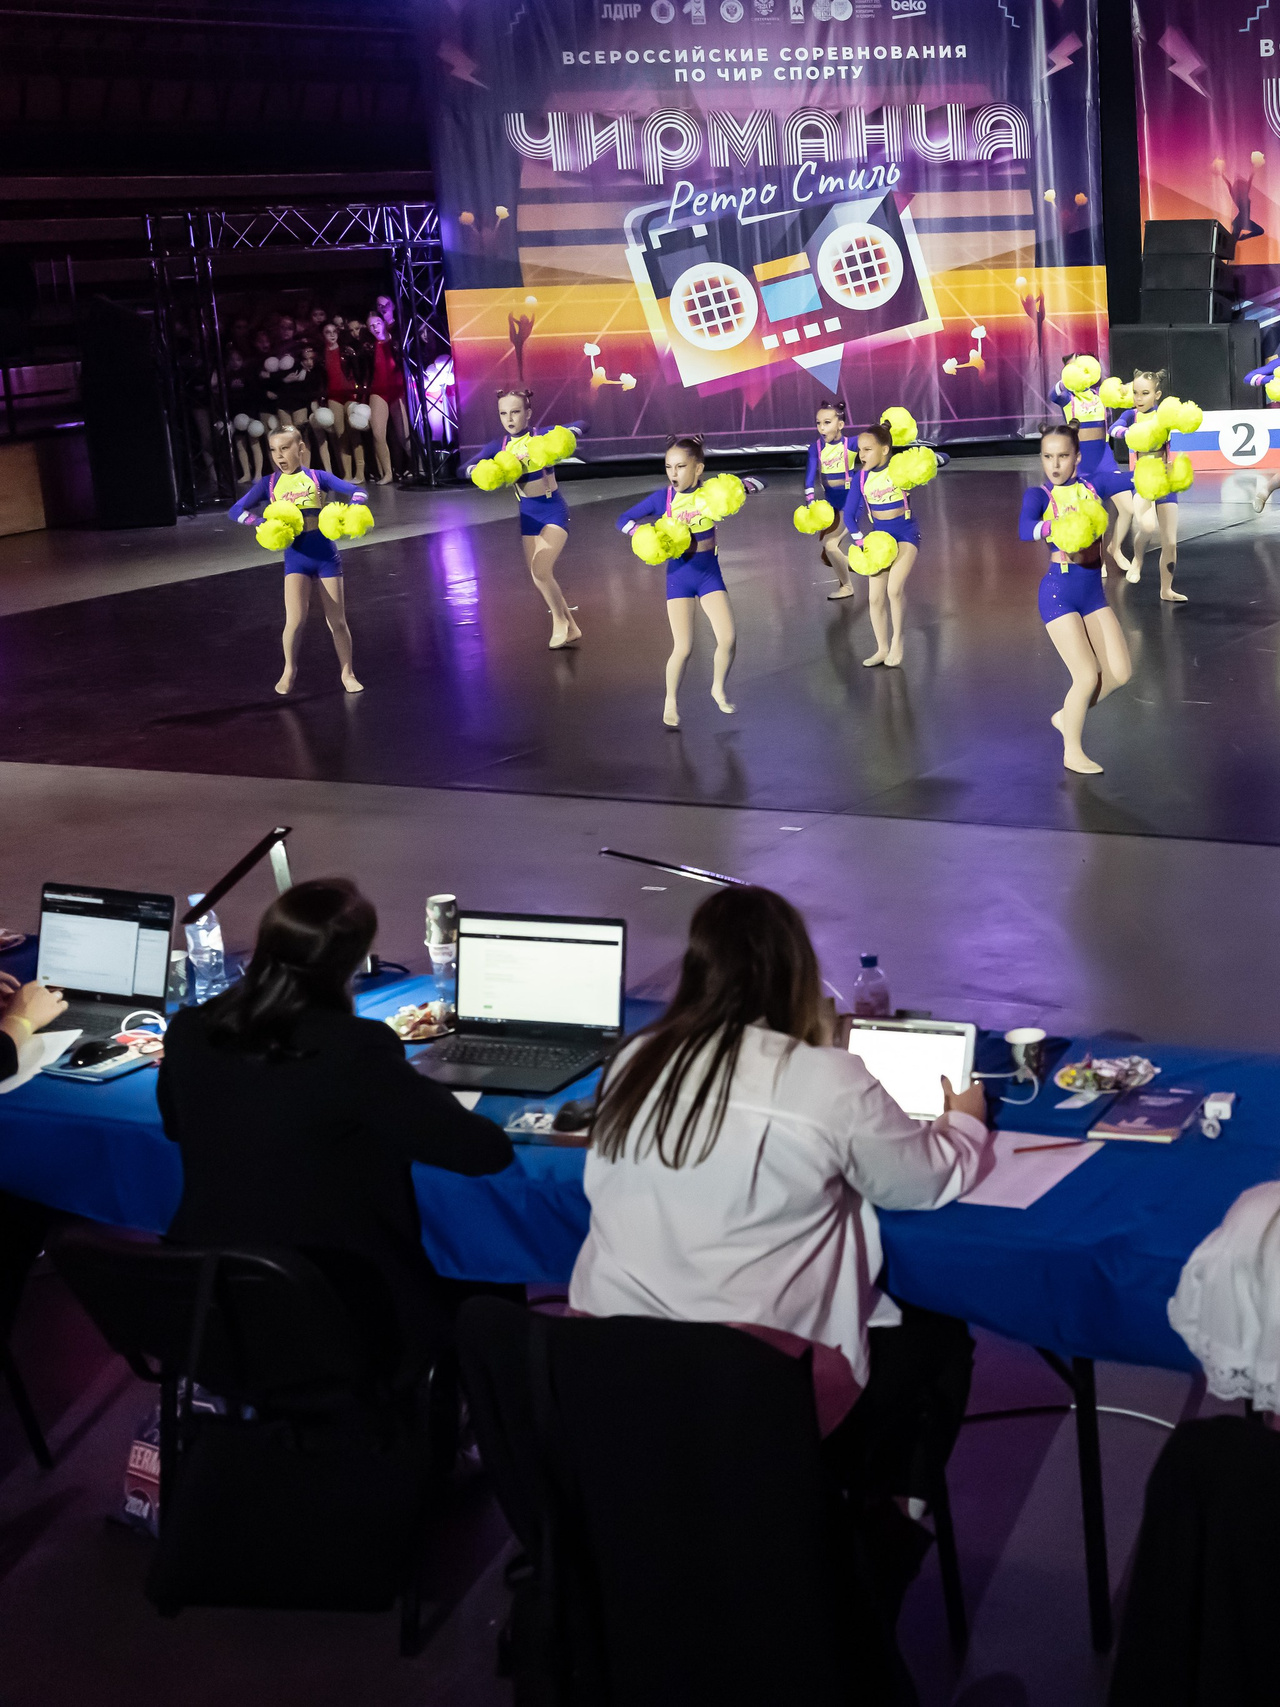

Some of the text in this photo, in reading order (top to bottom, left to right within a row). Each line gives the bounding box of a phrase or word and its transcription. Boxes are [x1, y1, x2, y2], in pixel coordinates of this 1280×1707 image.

[601, 3, 642, 20] ЛДПР
[892, 0, 927, 11] beko
[562, 44, 968, 65] ВСЕРОССИЙСКИЕ СОРЕВНОВАНИЯ
[675, 65, 864, 83] ПО ЧИР СПОРТУ
[668, 160, 901, 224] Ретро Стиль
[1231, 422, 1257, 457] 2
